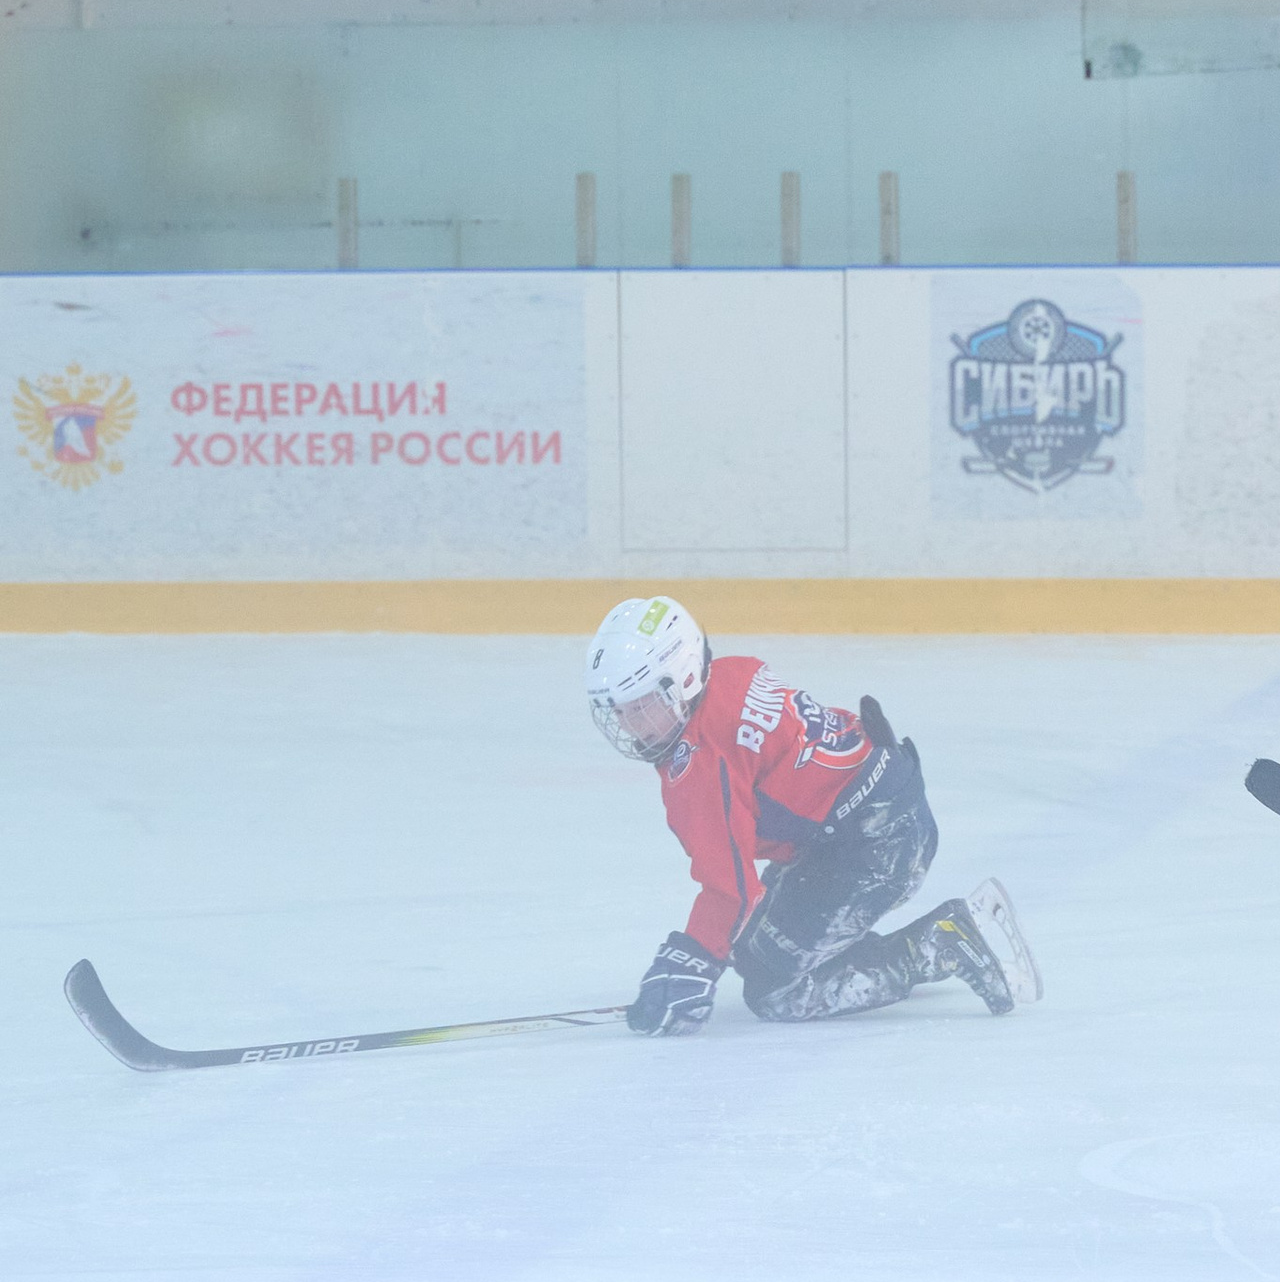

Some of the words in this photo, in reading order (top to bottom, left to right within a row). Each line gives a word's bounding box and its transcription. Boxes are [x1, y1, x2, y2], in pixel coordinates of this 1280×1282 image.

[169, 382, 447, 422] ФЕДЕРАЦИЯ
[955, 359, 1121, 431] СИБИРЬ
[171, 432, 355, 466] ХОККЕЯ
[370, 431, 562, 465] РОССИИ
[592, 648, 605, 670] 8
[836, 747, 892, 821] BAUER
[656, 946, 709, 974] UER
[239, 1038, 361, 1064] BAUER
